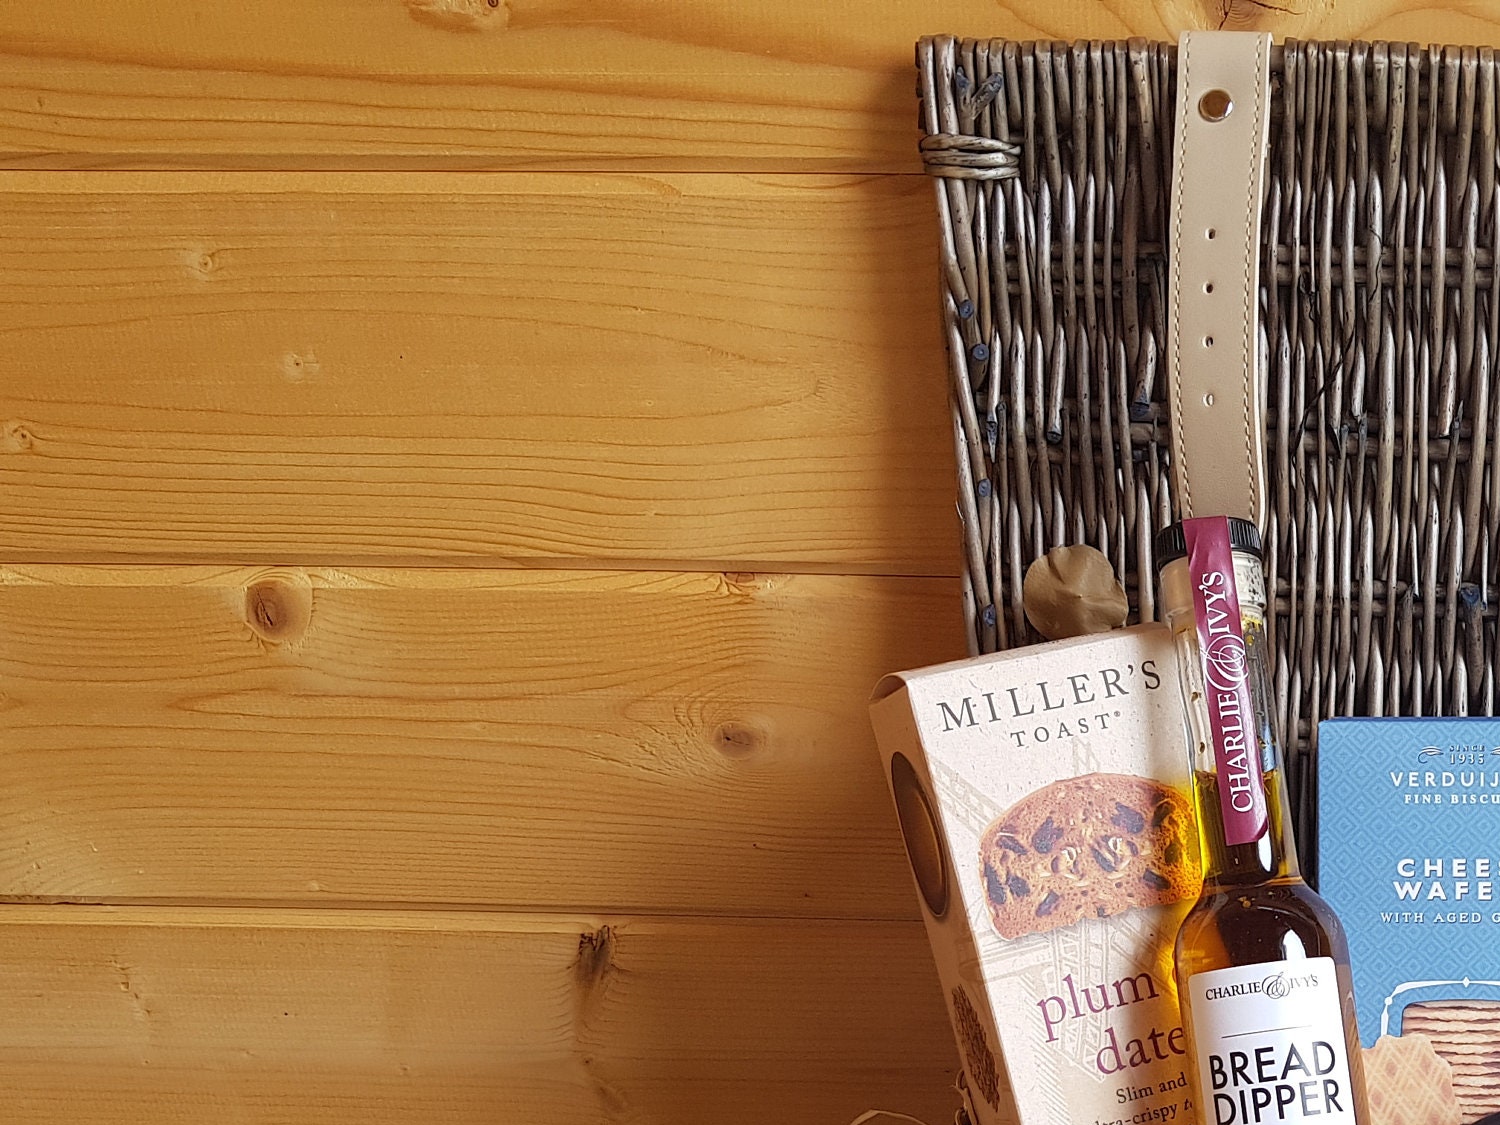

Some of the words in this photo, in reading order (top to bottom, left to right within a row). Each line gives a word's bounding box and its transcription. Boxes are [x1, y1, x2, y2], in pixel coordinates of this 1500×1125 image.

[1199, 571, 1231, 637] IVY'S
[936, 659, 1163, 733] MILLER'S
[1217, 690, 1254, 813] CHARLIE
[1449, 744, 1486, 753] SINCE
[1449, 753, 1486, 765] 1935
[1404, 794, 1443, 805] FINE
[1380, 912, 1425, 924] WITH
[1433, 912, 1483, 924] AGED
[1205, 982, 1262, 1001] CHARLIE
[1290, 974, 1320, 989] IVY'S
[1036, 972, 1160, 1043] plum
[1208, 1040, 1336, 1090] BREAD
[1116, 1086, 1154, 1104] Slim
[1158, 1071, 1188, 1093] and
